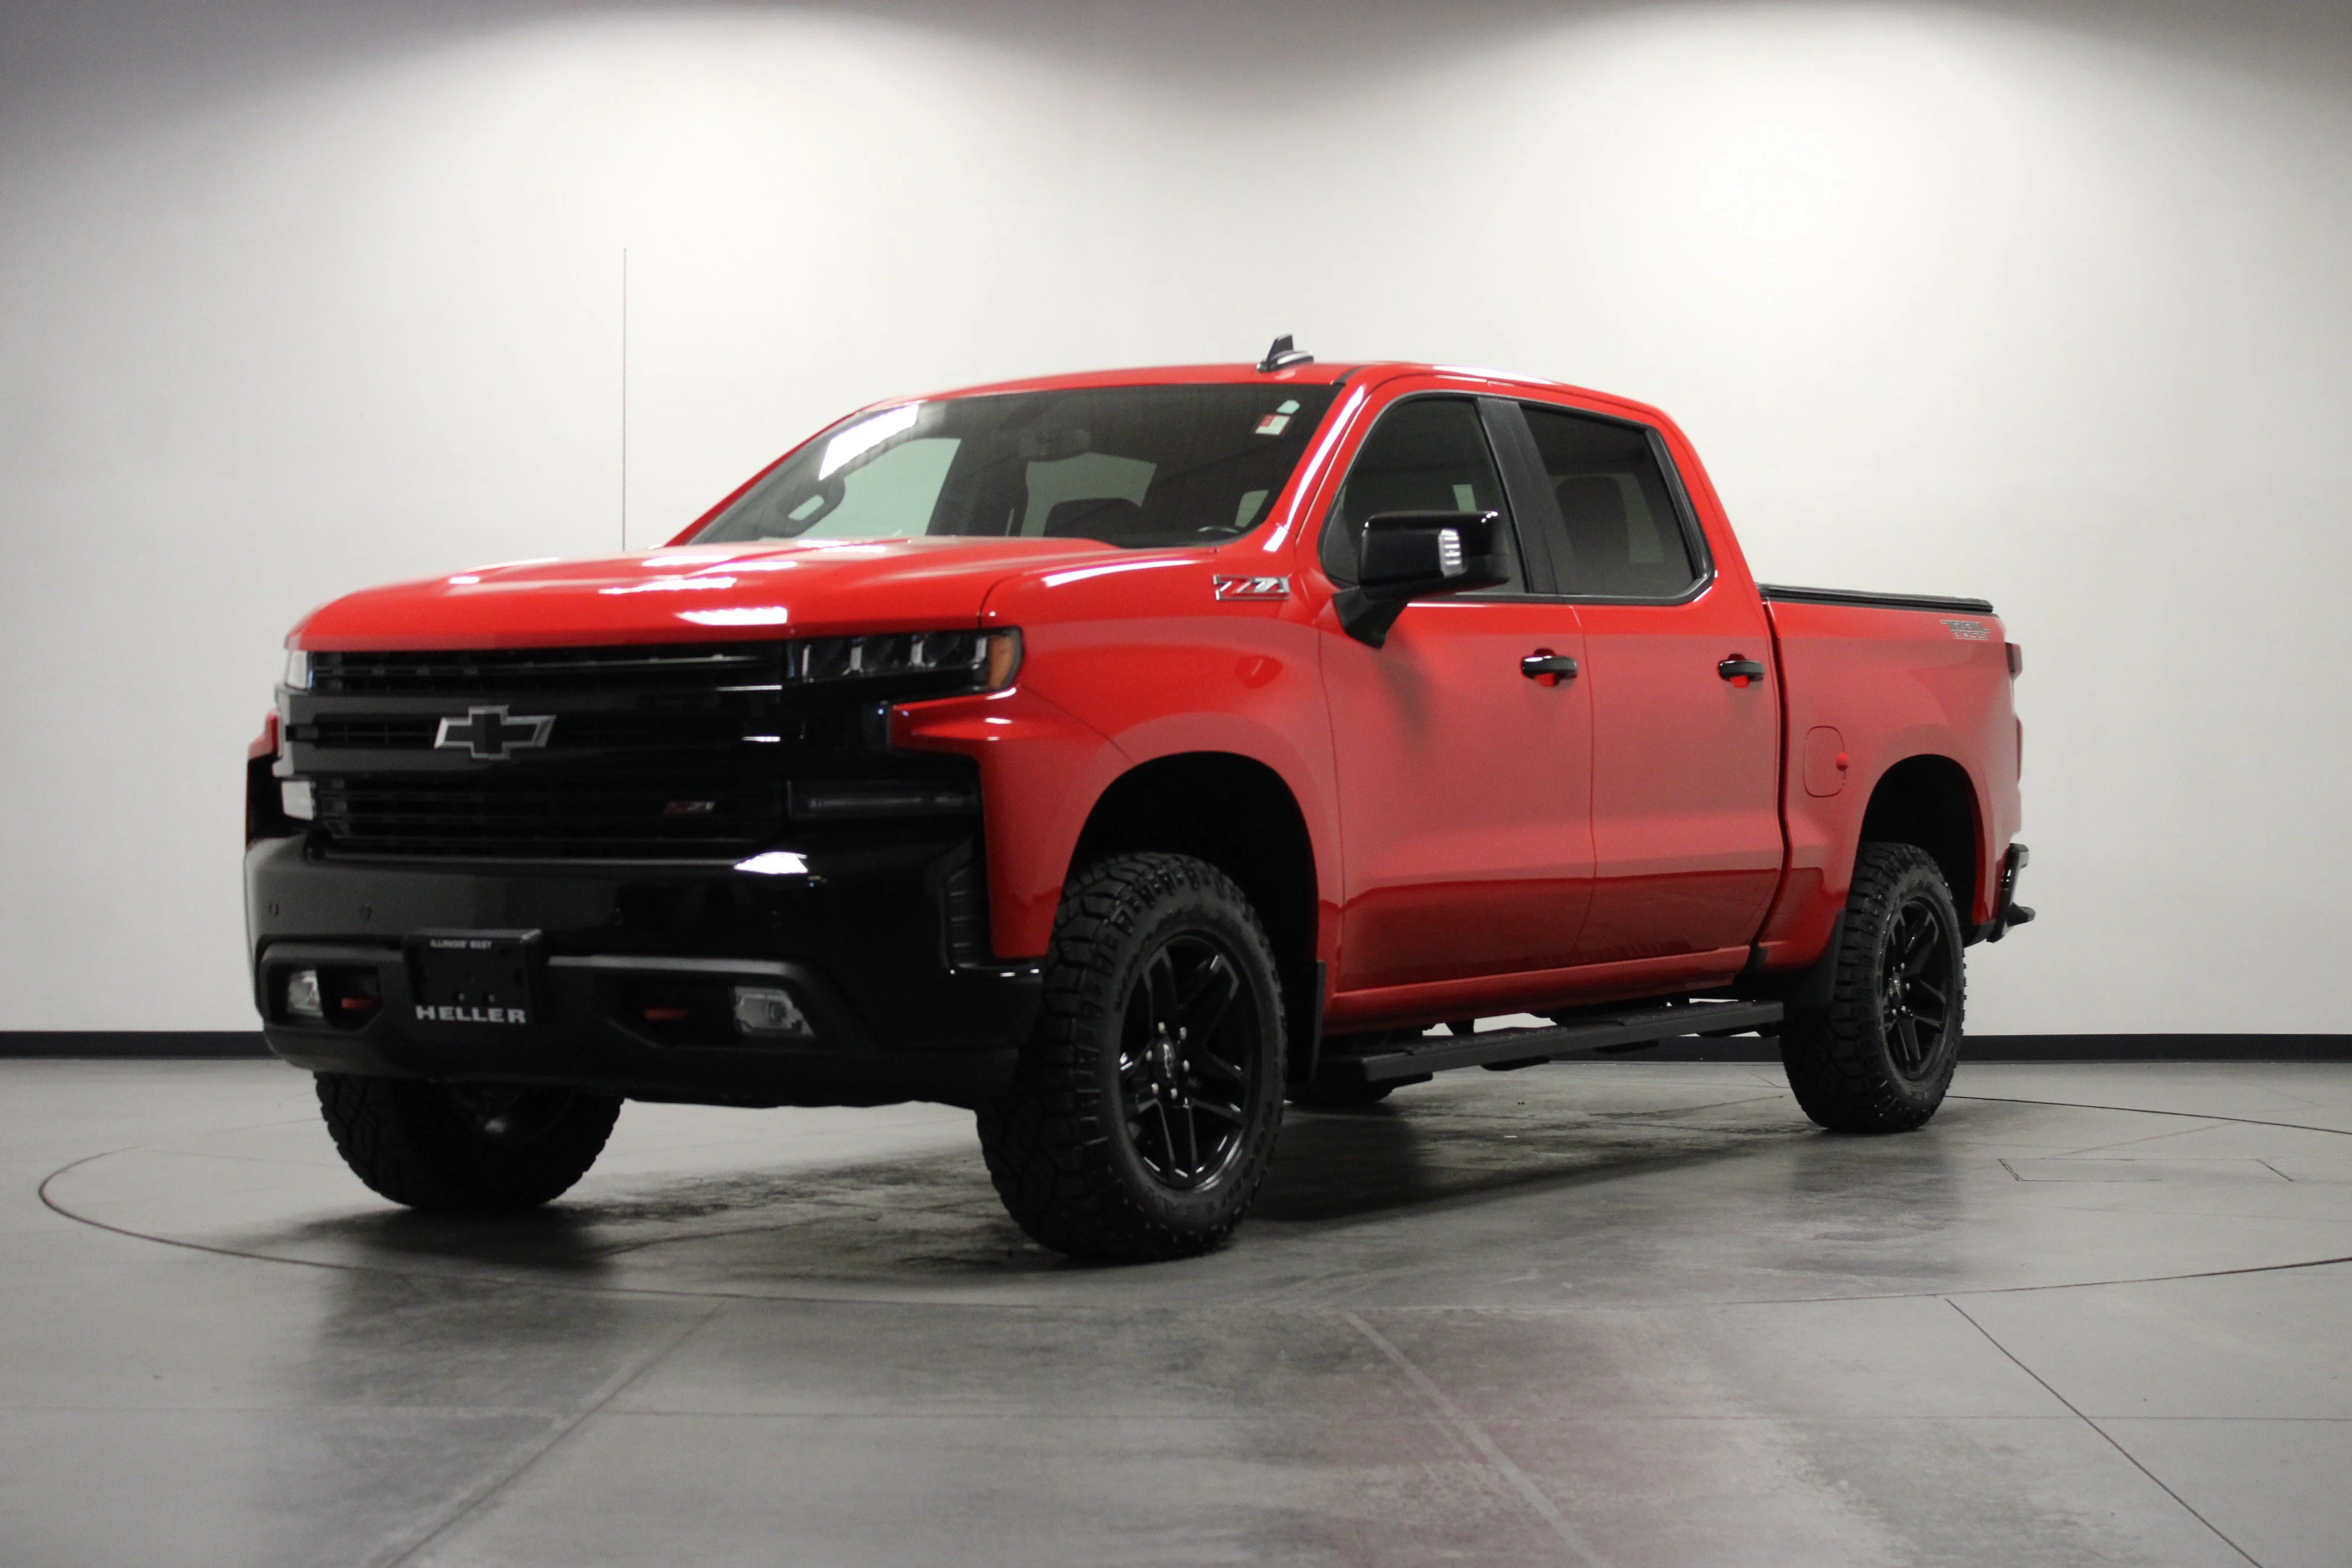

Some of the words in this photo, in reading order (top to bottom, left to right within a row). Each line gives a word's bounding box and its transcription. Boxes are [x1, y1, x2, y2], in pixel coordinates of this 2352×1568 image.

[1939, 620, 1990, 633] TRAIL
[1953, 631, 1989, 640] BOSS
[415, 1004, 527, 1024] HELLER
